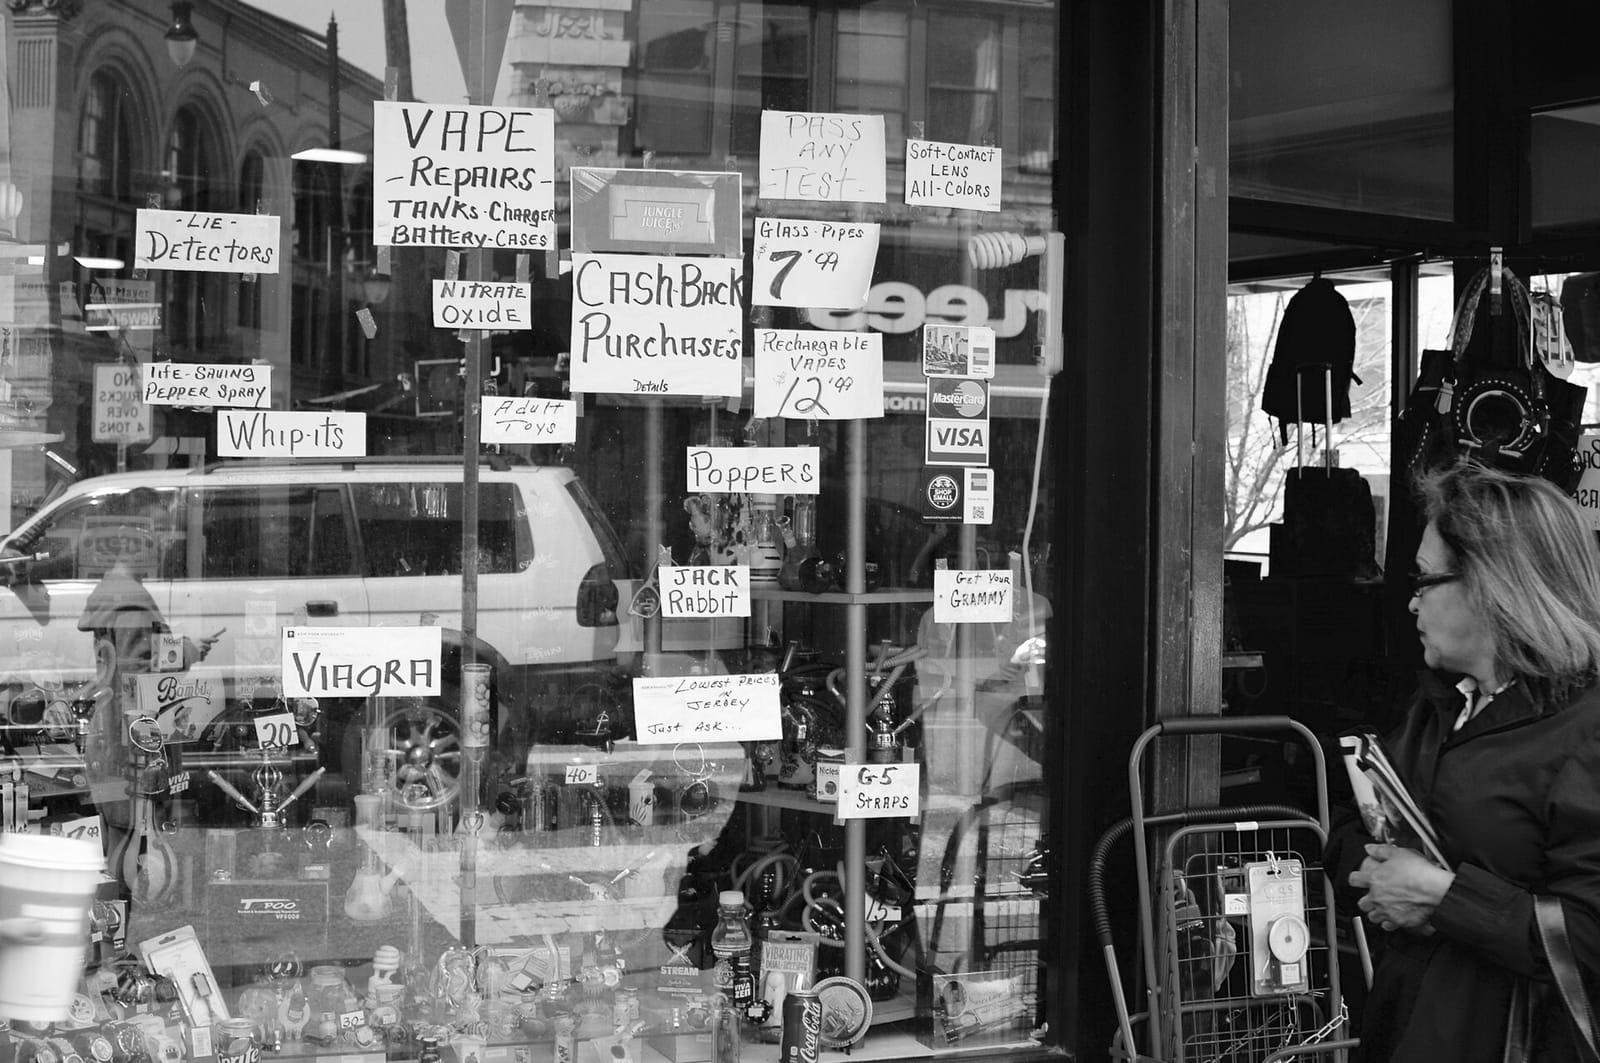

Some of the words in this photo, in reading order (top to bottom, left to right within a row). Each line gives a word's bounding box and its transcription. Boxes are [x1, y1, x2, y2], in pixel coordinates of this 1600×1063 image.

[402, 108, 536, 152] VAPE
[786, 114, 862, 141] PASS
[799, 142, 854, 163] ANY
[931, 165, 969, 178] LENS
[643, 206, 684, 218] JUNGLE
[187, 214, 223, 230] LIE
[641, 216, 672, 229] JUICE
[146, 231, 273, 263] DETECTORS
[440, 282, 527, 299] NITRATE
[791, 355, 847, 371] VAPES
[146, 383, 211, 402] PEPPER
[218, 385, 267, 408] SPRAY
[932, 393, 985, 406] MasterCard
[936, 428, 985, 448] VISA
[690, 450, 814, 491] POPPERS
[933, 494, 954, 502] SMALL
[934, 488, 952, 496] SHOP
[674, 568, 738, 587] JACK
[950, 588, 1008, 608] GRAMMY
[719, 690, 732, 699] IN
[687, 698, 752, 712] JERSEY
[168, 771, 191, 785] VIVA
[857, 766, 899, 785] G-5
[856, 793, 909, 809] STRAPS
[765, 947, 808, 962] VIBRATING
[661, 966, 699, 976] STREAM
[735, 982, 751, 991] VIVA
